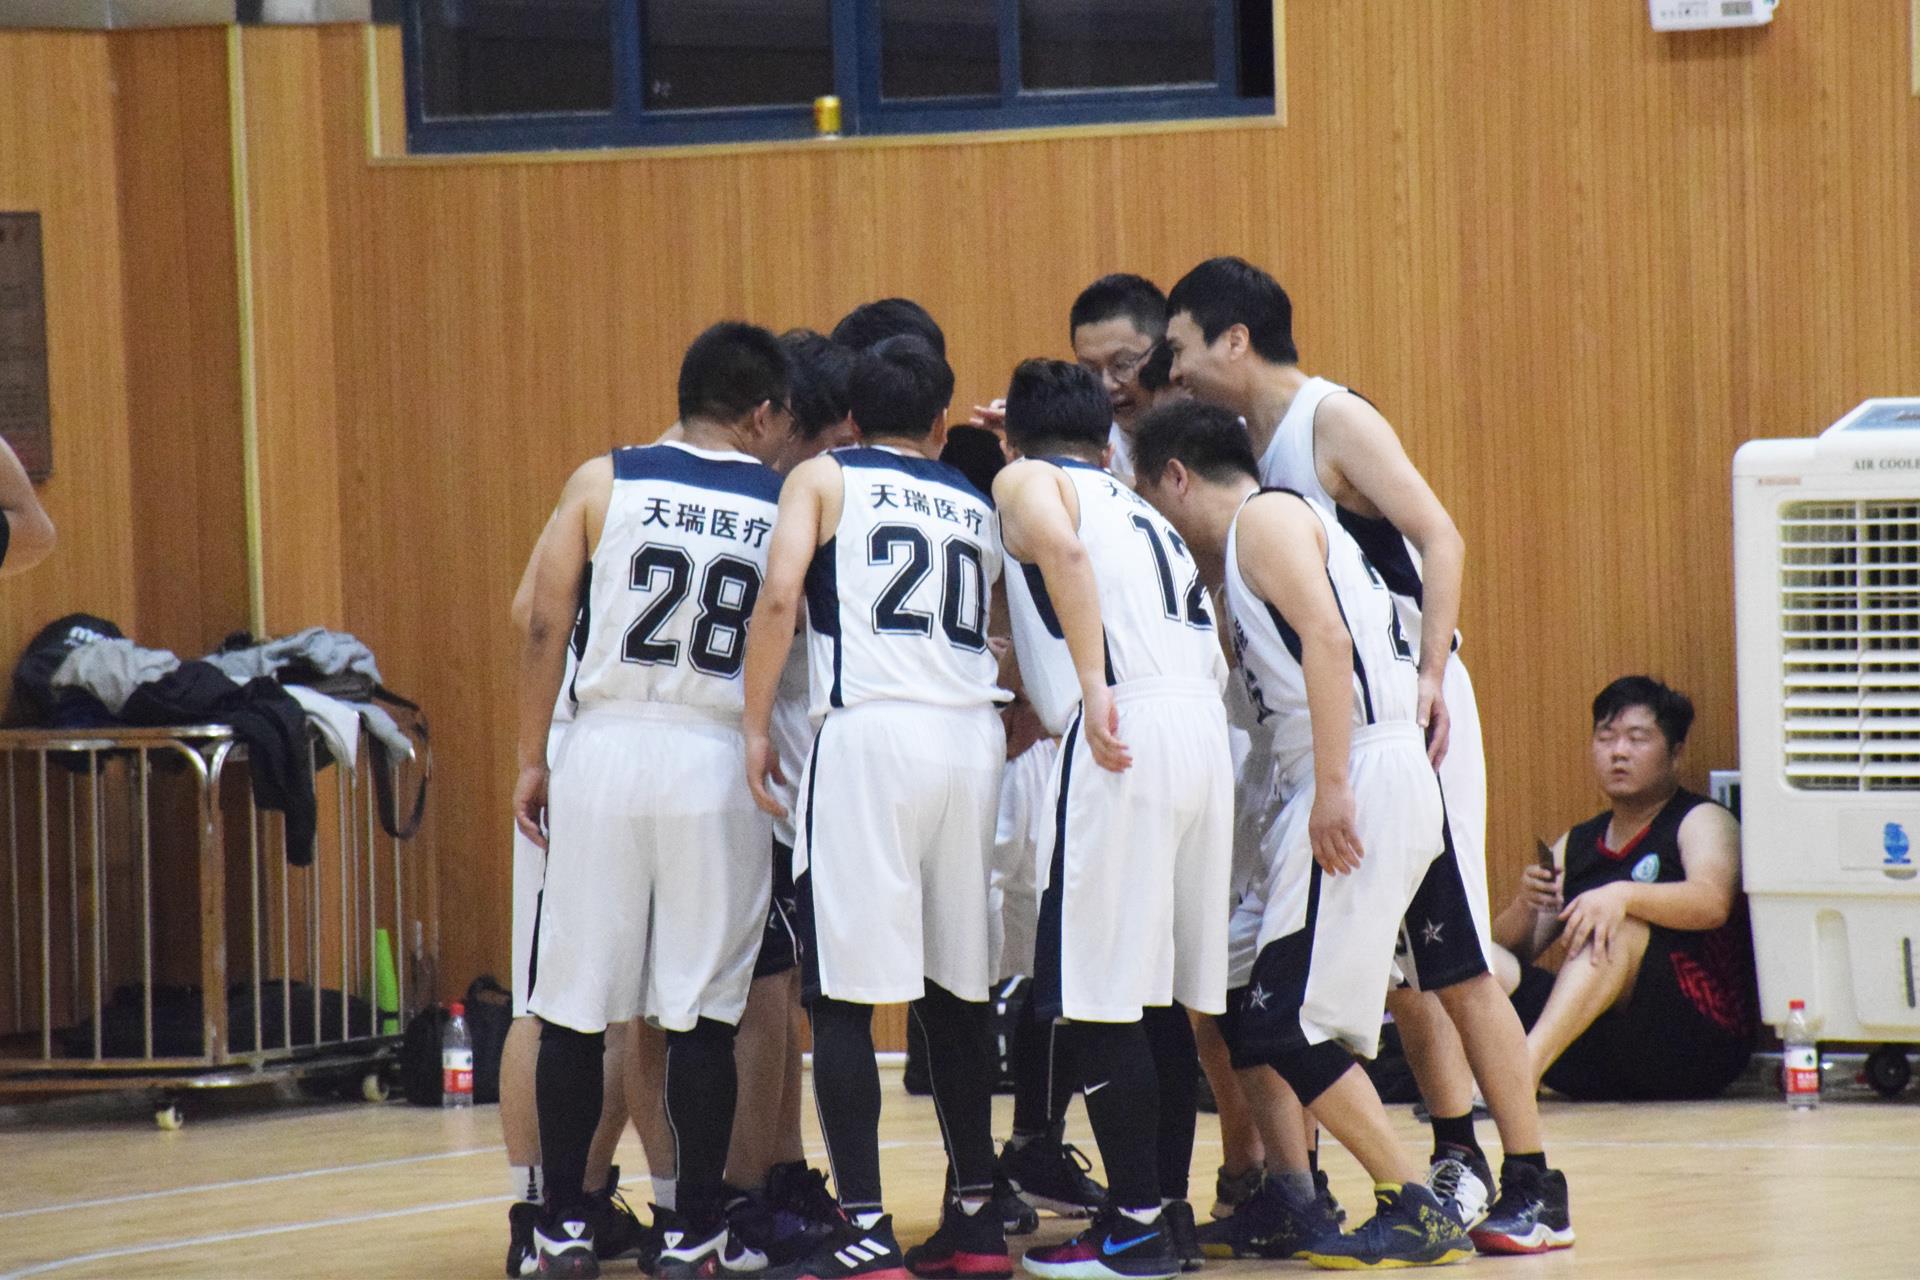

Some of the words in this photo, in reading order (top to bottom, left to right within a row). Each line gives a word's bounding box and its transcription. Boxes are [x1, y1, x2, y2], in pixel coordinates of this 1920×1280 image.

[1852, 457, 1874, 470] AIR
[642, 497, 772, 548] 天瑞医疗
[871, 484, 984, 535] 天瑞医疗
[621, 541, 765, 680] 28
[867, 521, 989, 655] 20
[1128, 511, 1214, 630] 12
